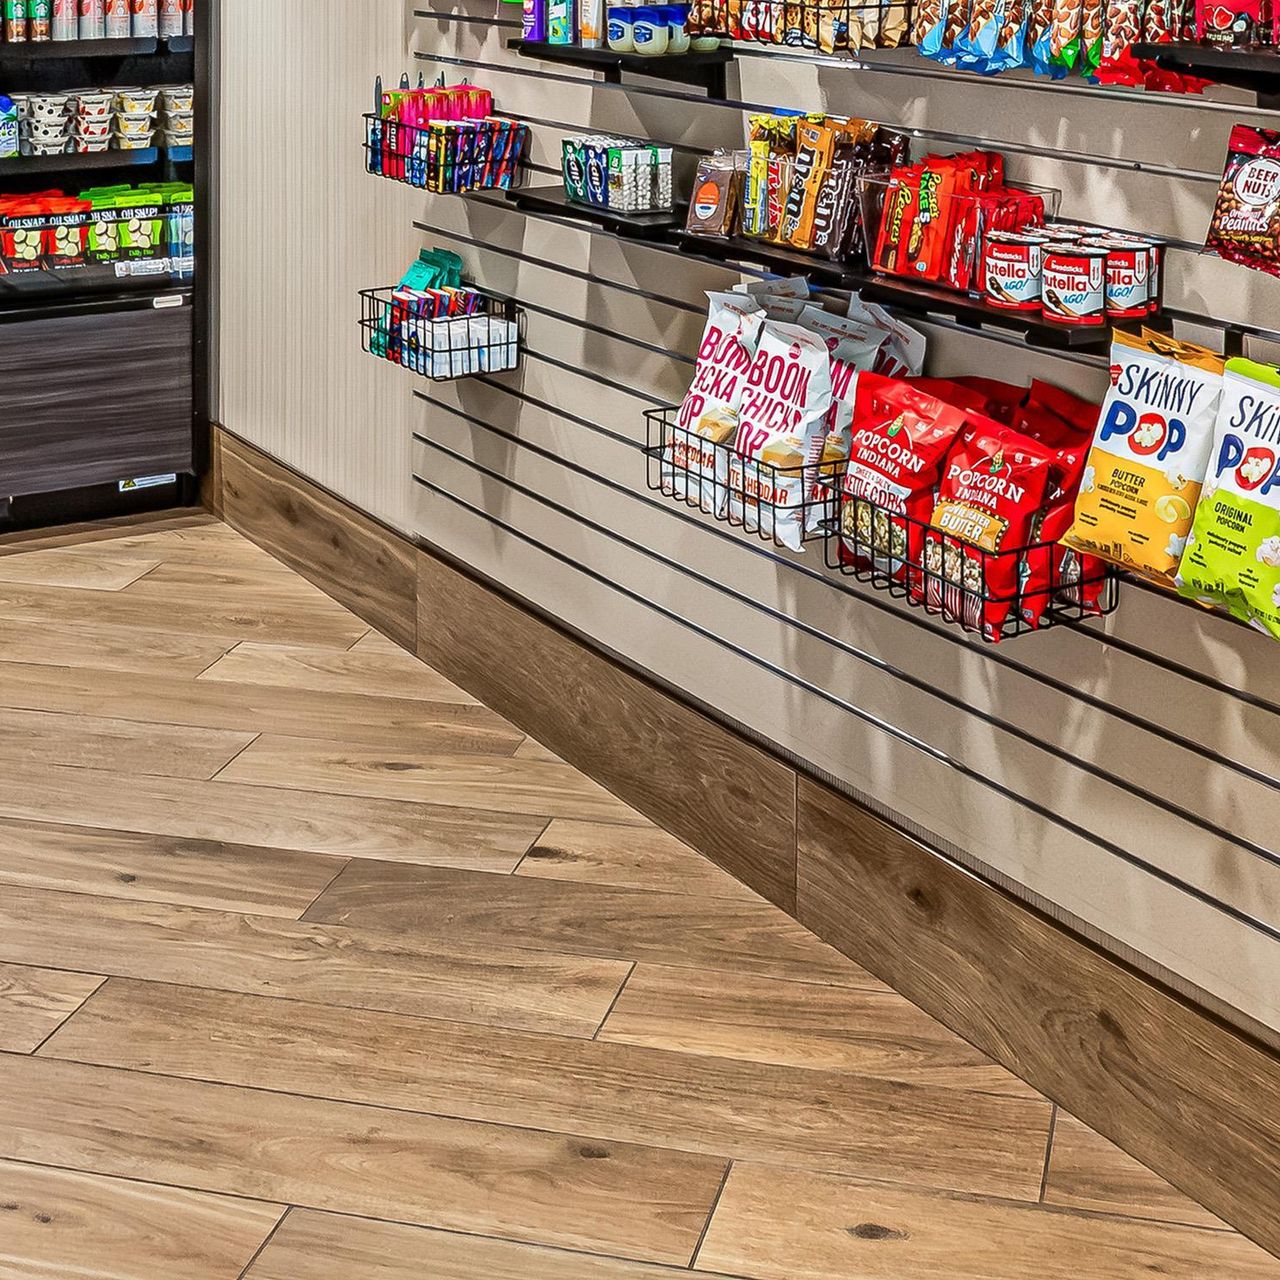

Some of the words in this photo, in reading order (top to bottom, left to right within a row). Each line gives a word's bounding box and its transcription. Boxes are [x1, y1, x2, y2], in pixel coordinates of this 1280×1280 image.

[566, 144, 584, 197] eclipse
[588, 147, 604, 203] eclipse
[1248, 167, 1278, 183] BEER
[1242, 182, 1272, 198] NUTS
[1220, 216, 1269, 232] Peanuts
[1229, 208, 1261, 219] Original
[1004, 278, 1029, 291] &GO!
[1063, 291, 1089, 304] &GO!
[749, 350, 812, 409] BOOM
[1118, 363, 1204, 416] SKINNY
[1099, 400, 1187, 463] POP
[853, 429, 926, 473] POPCORN
[857, 447, 900, 478] INDIANA
[946, 464, 1025, 504] POPCORN
[1109, 479, 1140, 495] POPCORN
[1111, 468, 1146, 488] BUTTER
[956, 486, 997, 509] INDIANA
[1214, 501, 1254, 526] ORIGINAL
[1216, 515, 1246, 533] POPCORN
[939, 513, 983, 541] BUTTER
